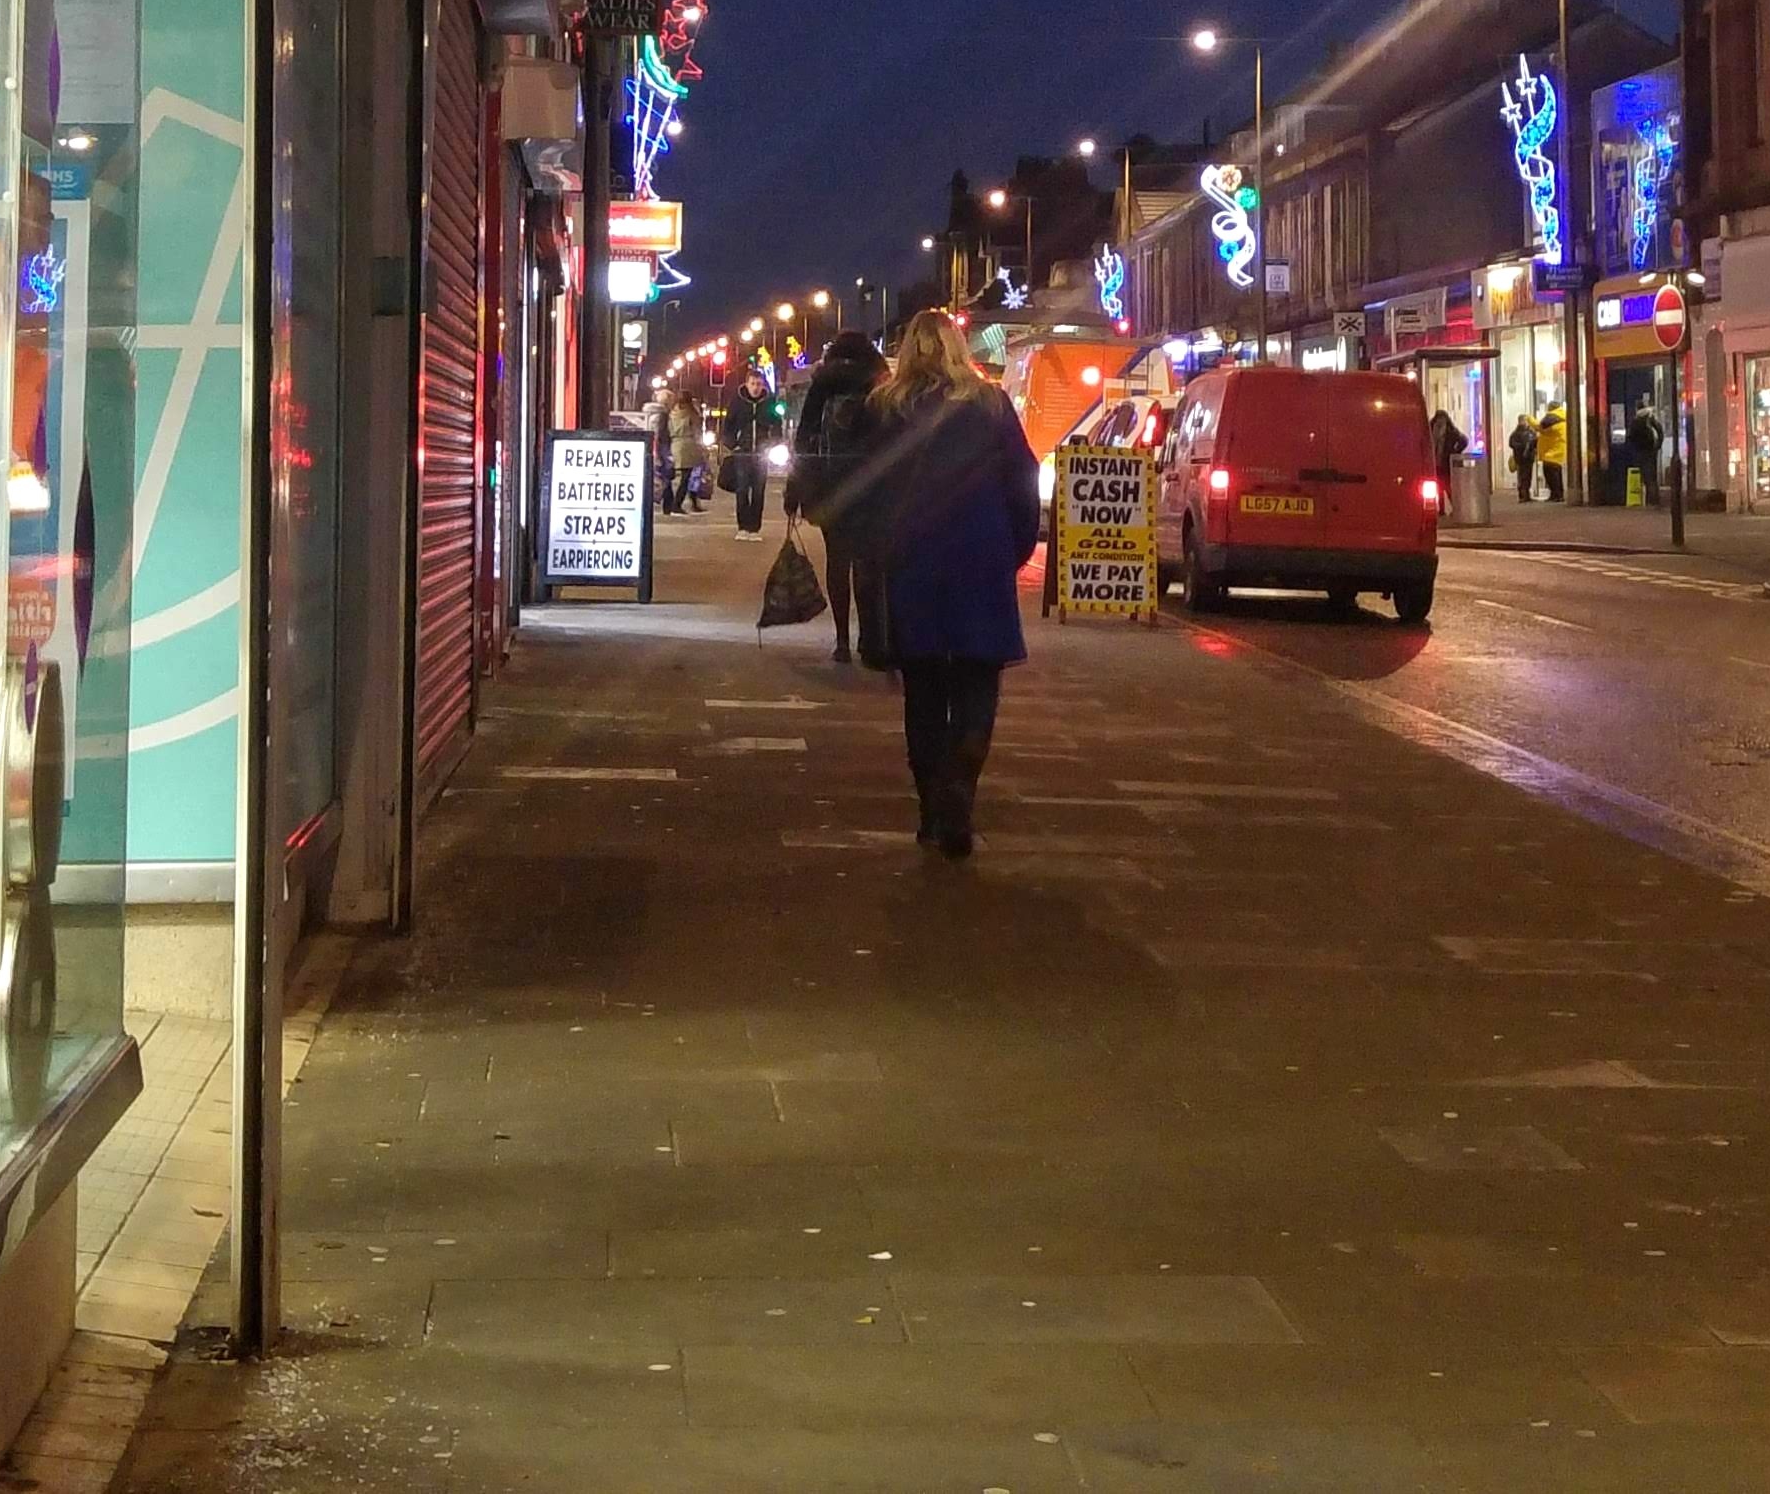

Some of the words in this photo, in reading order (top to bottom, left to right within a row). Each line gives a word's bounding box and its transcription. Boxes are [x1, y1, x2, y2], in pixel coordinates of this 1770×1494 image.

[564, 449, 632, 468] REPAIRS
[1069, 457, 1143, 477] INSTANT
[557, 481, 635, 502] BATTERIES
[1072, 478, 1141, 504] CASH
[1245, 497, 1280, 511] LG57
[563, 514, 626, 536] STRAPS
[1090, 528, 1126, 538] ALL
[1078, 538, 1137, 551] GOLD
[552, 548, 633, 570] EARPIERCING
[1069, 551, 1090, 561] ANY
[1092, 552, 1145, 562] CONDITION
[1070, 563, 1102, 581] WE
[1107, 565, 1144, 583] PAY
[1071, 583, 1145, 602] MORE
